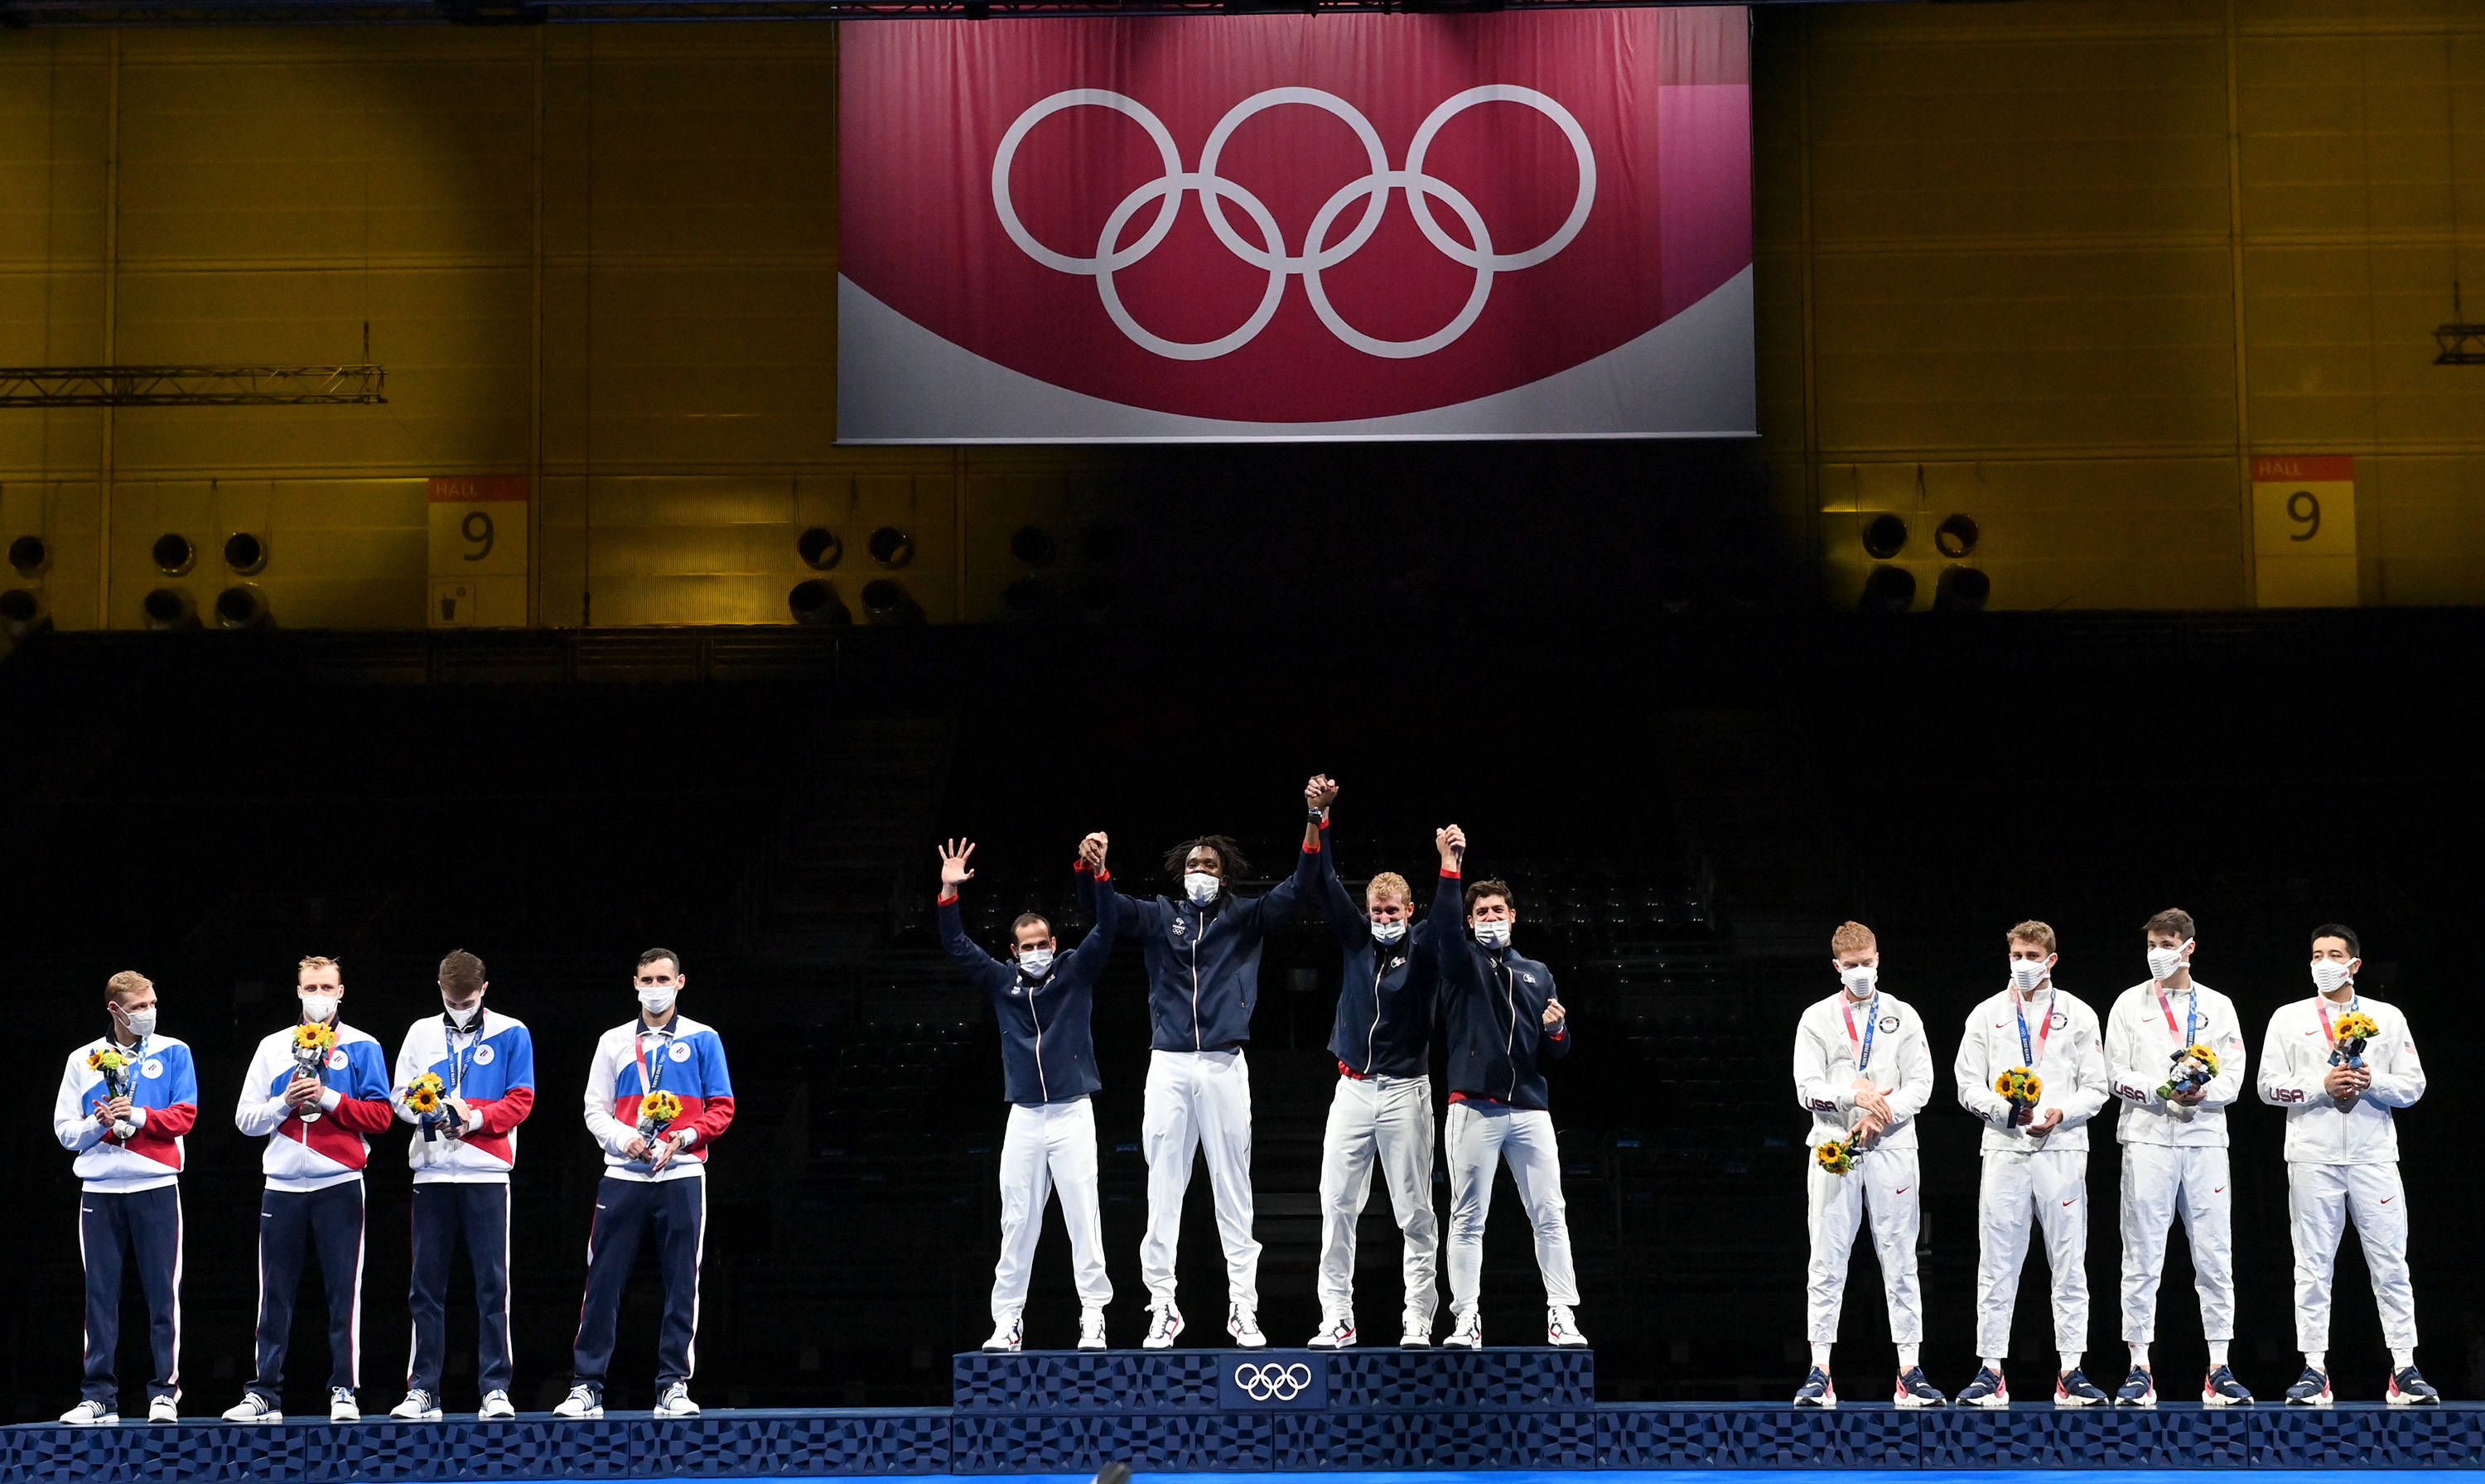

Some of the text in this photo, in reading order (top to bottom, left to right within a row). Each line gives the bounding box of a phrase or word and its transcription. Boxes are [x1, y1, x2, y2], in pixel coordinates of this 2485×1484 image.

[2258, 462, 2302, 476] HALL
[436, 483, 478, 497] HALL
[2286, 491, 2321, 542] 9
[461, 511, 495, 561] 9
[2113, 1081, 2147, 1104] USA
[2269, 1086, 2305, 1102] USA
[1805, 1096, 1839, 1112] USA
